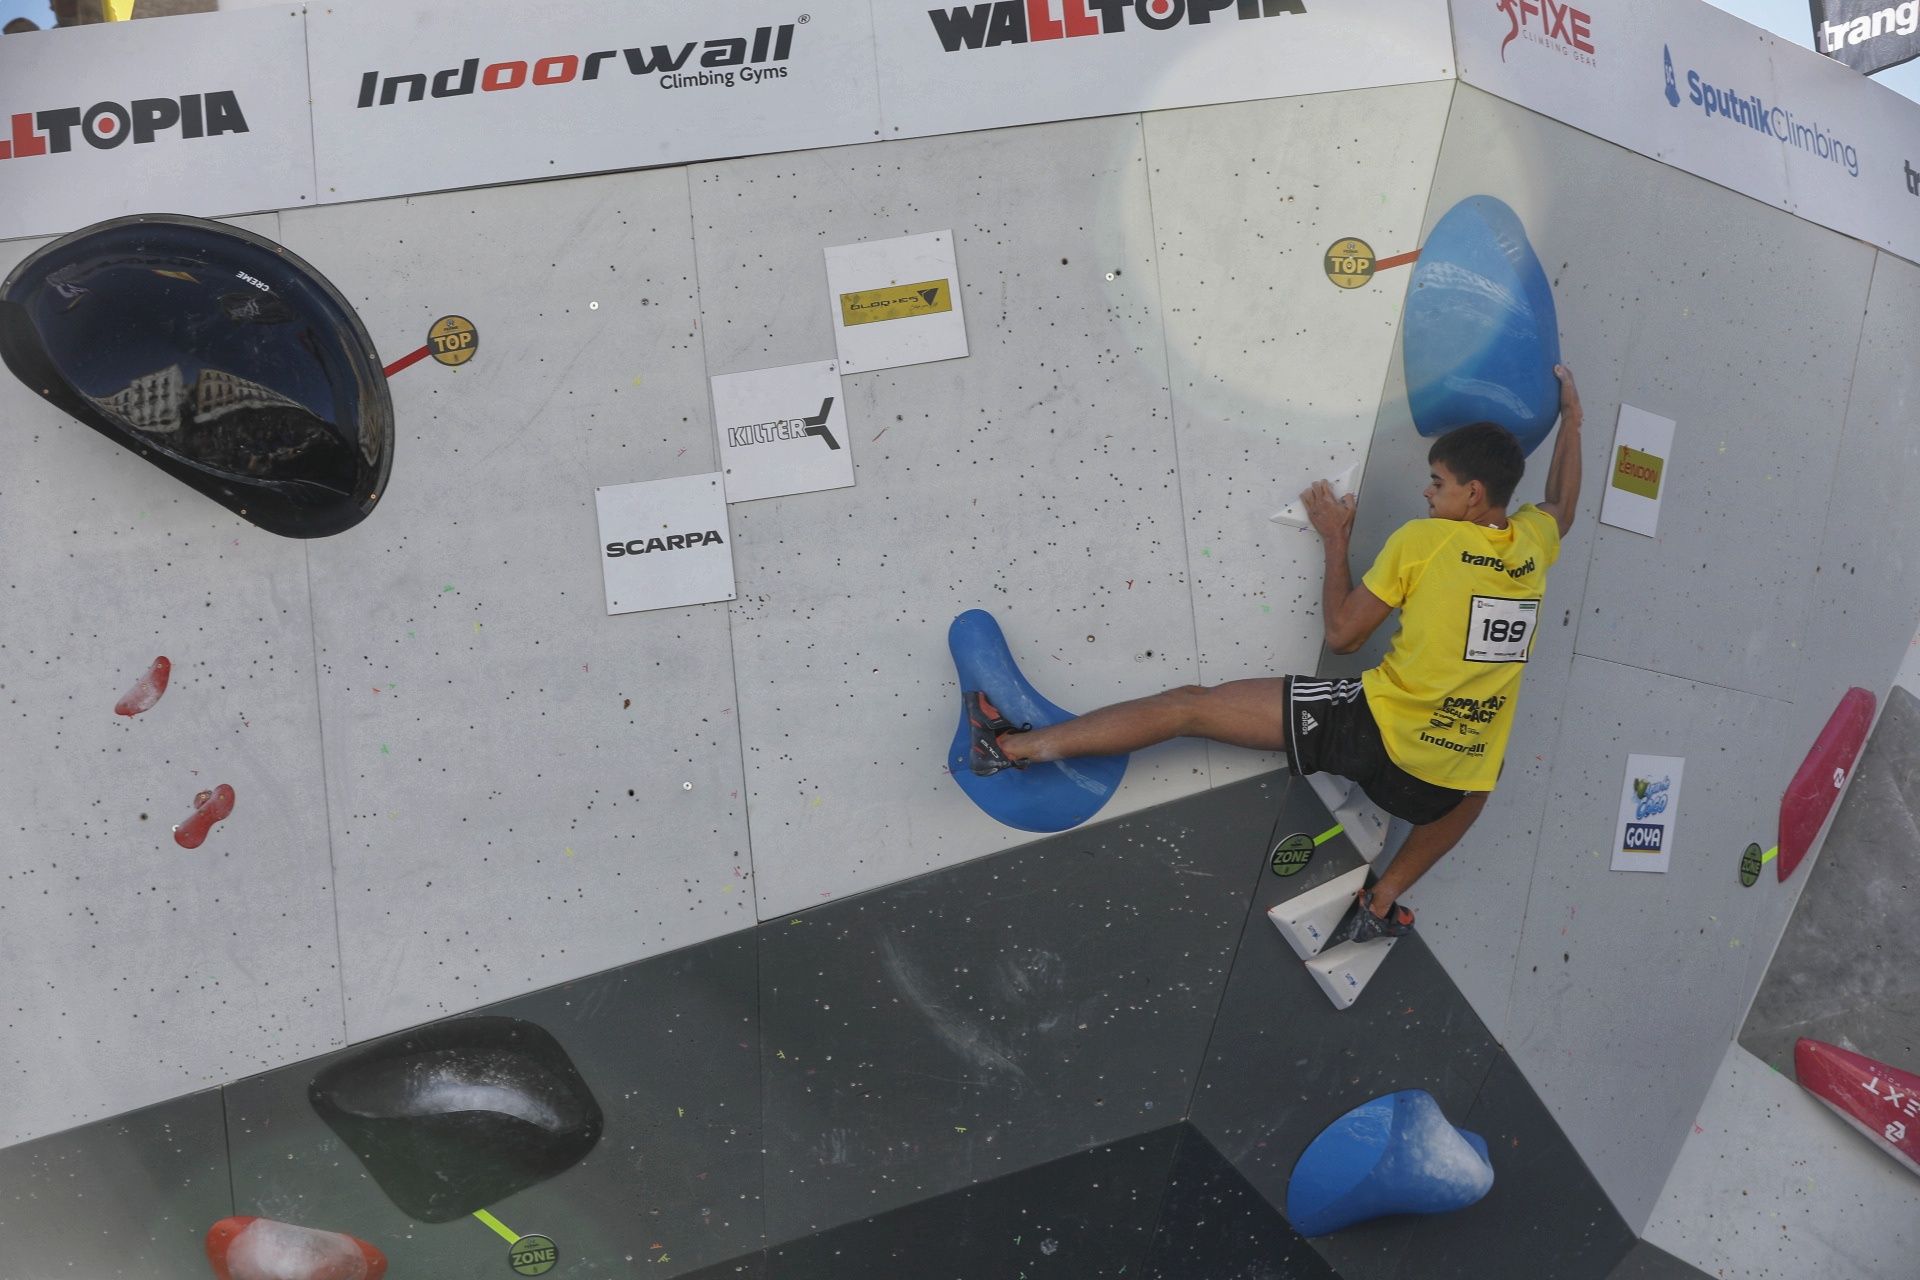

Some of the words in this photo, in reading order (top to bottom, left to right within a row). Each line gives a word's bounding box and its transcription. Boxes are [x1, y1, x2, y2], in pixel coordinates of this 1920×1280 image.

[1519, 0, 1595, 54] FIXE
[1817, 0, 1920, 54] trang
[1522, 29, 1568, 56] CLIMBING
[1573, 50, 1596, 68] GEAR
[357, 24, 795, 108] Indoorwall
[660, 69, 734, 90] Climbing
[739, 66, 788, 84] Gyms
[1331, 257, 1370, 274] TOP
[236, 270, 270, 292] CREME
[434, 332, 472, 352] TOP
[727, 418, 807, 447] KILTER
[606, 530, 724, 558] SCARPA
[1483, 619, 1527, 643] 189
[1420, 732, 1486, 753] Indoorall
[1626, 827, 1661, 848] GOYA
[1272, 850, 1311, 864] ZONE
[512, 1248, 556, 1266] ZONE
